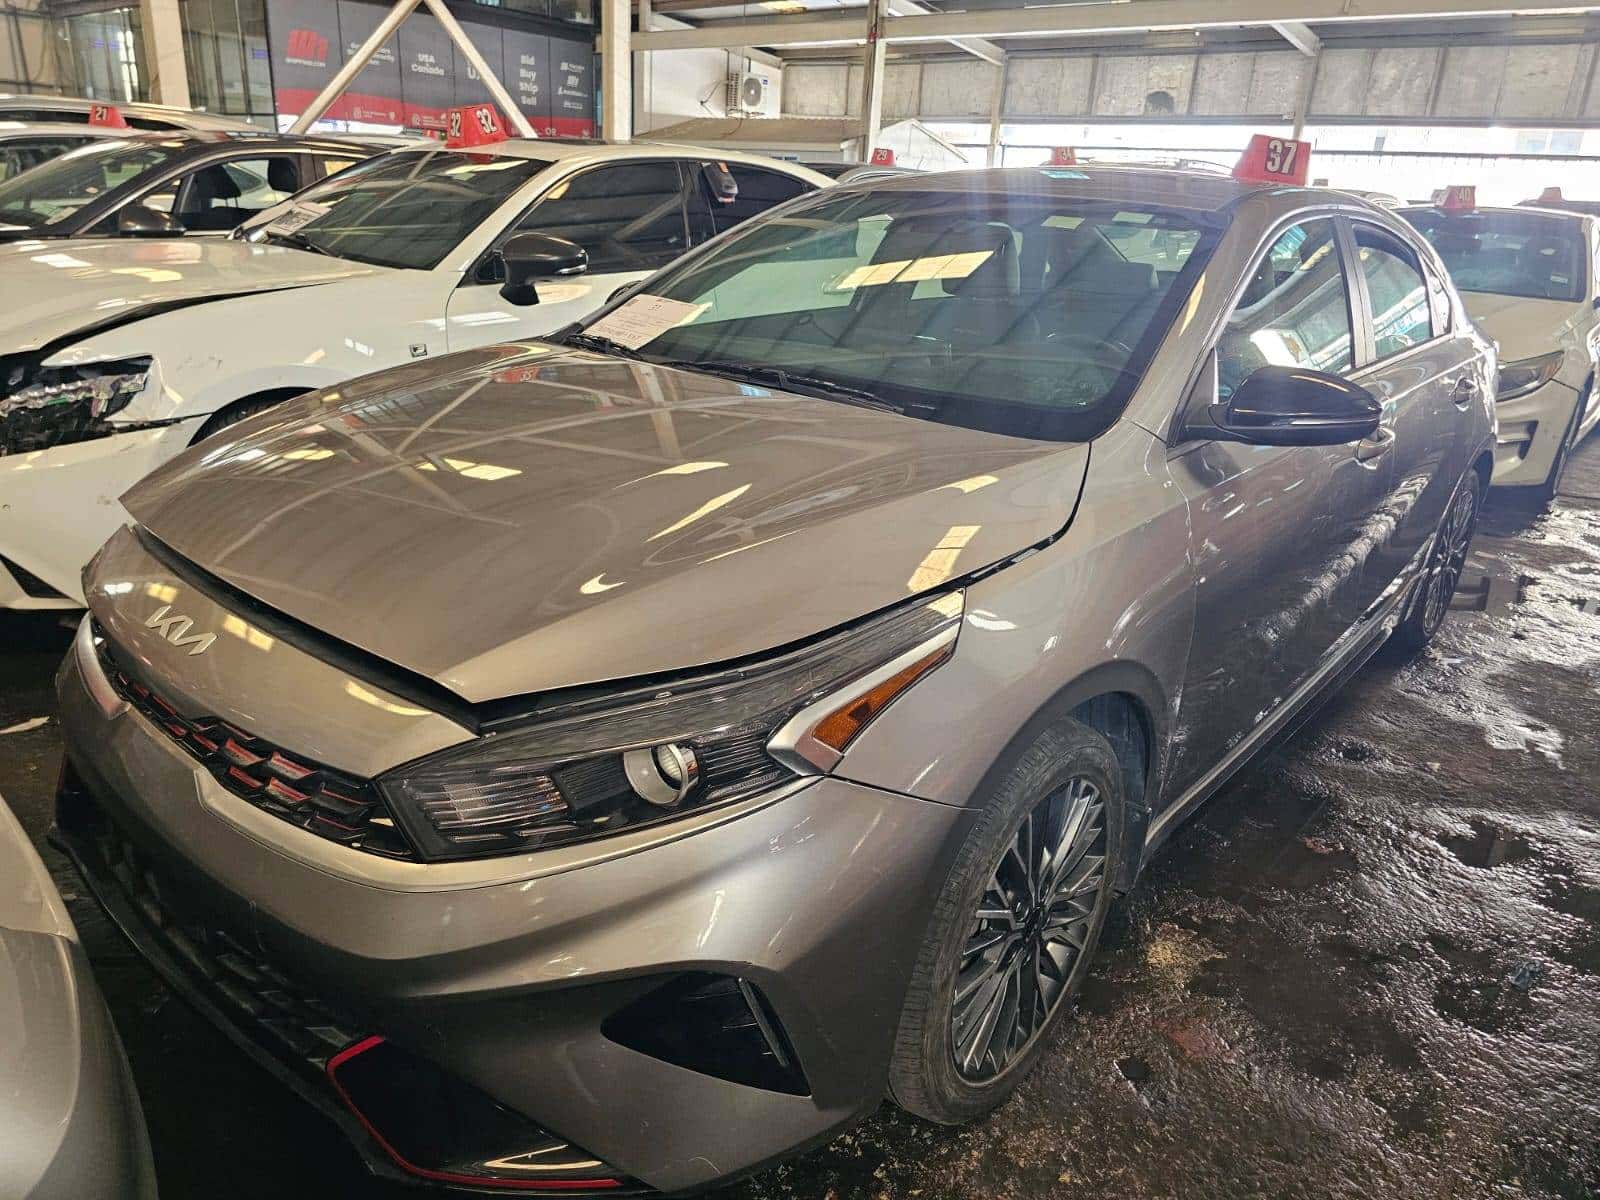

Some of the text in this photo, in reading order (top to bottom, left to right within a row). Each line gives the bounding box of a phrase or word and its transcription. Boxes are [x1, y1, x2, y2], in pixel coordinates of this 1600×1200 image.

[411, 63, 445, 76] Canada
[519, 68, 536, 81] Buy
[519, 82, 538, 95] Ship
[95, 106, 107, 121] 21
[476, 108, 497, 134] 32
[450, 111, 461, 137] 32
[876, 150, 888, 161] 29
[1266, 139, 1298, 174] 37
[144, 604, 218, 656] KIA
